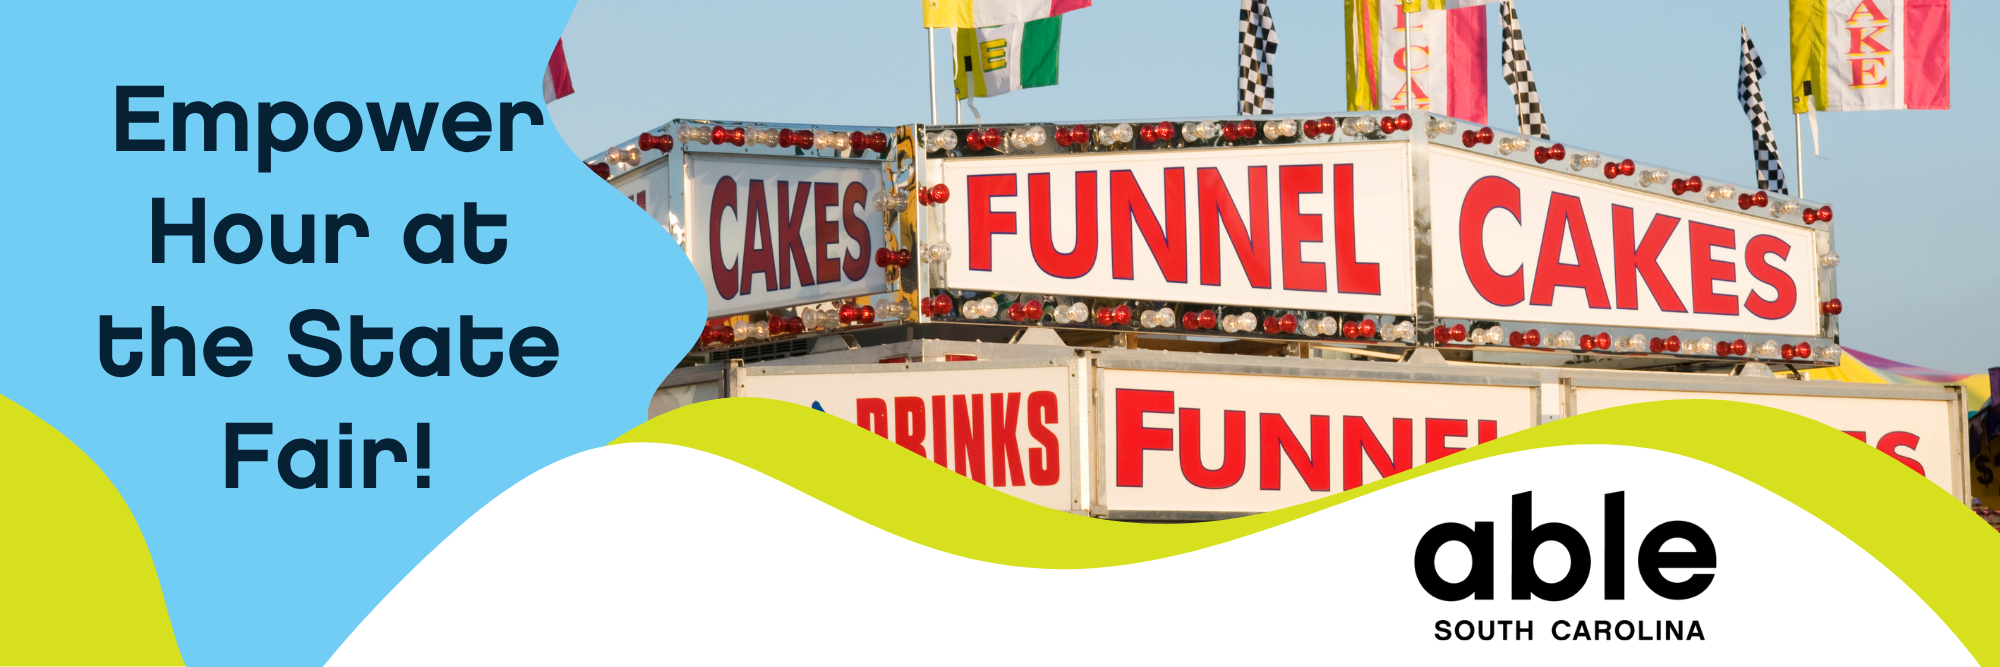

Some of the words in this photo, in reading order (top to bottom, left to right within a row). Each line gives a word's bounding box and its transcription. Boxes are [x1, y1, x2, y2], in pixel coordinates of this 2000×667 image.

[709, 175, 872, 300] CAKES
[966, 162, 1382, 296] FUNNEL
[1457, 175, 1798, 320] CAKES
